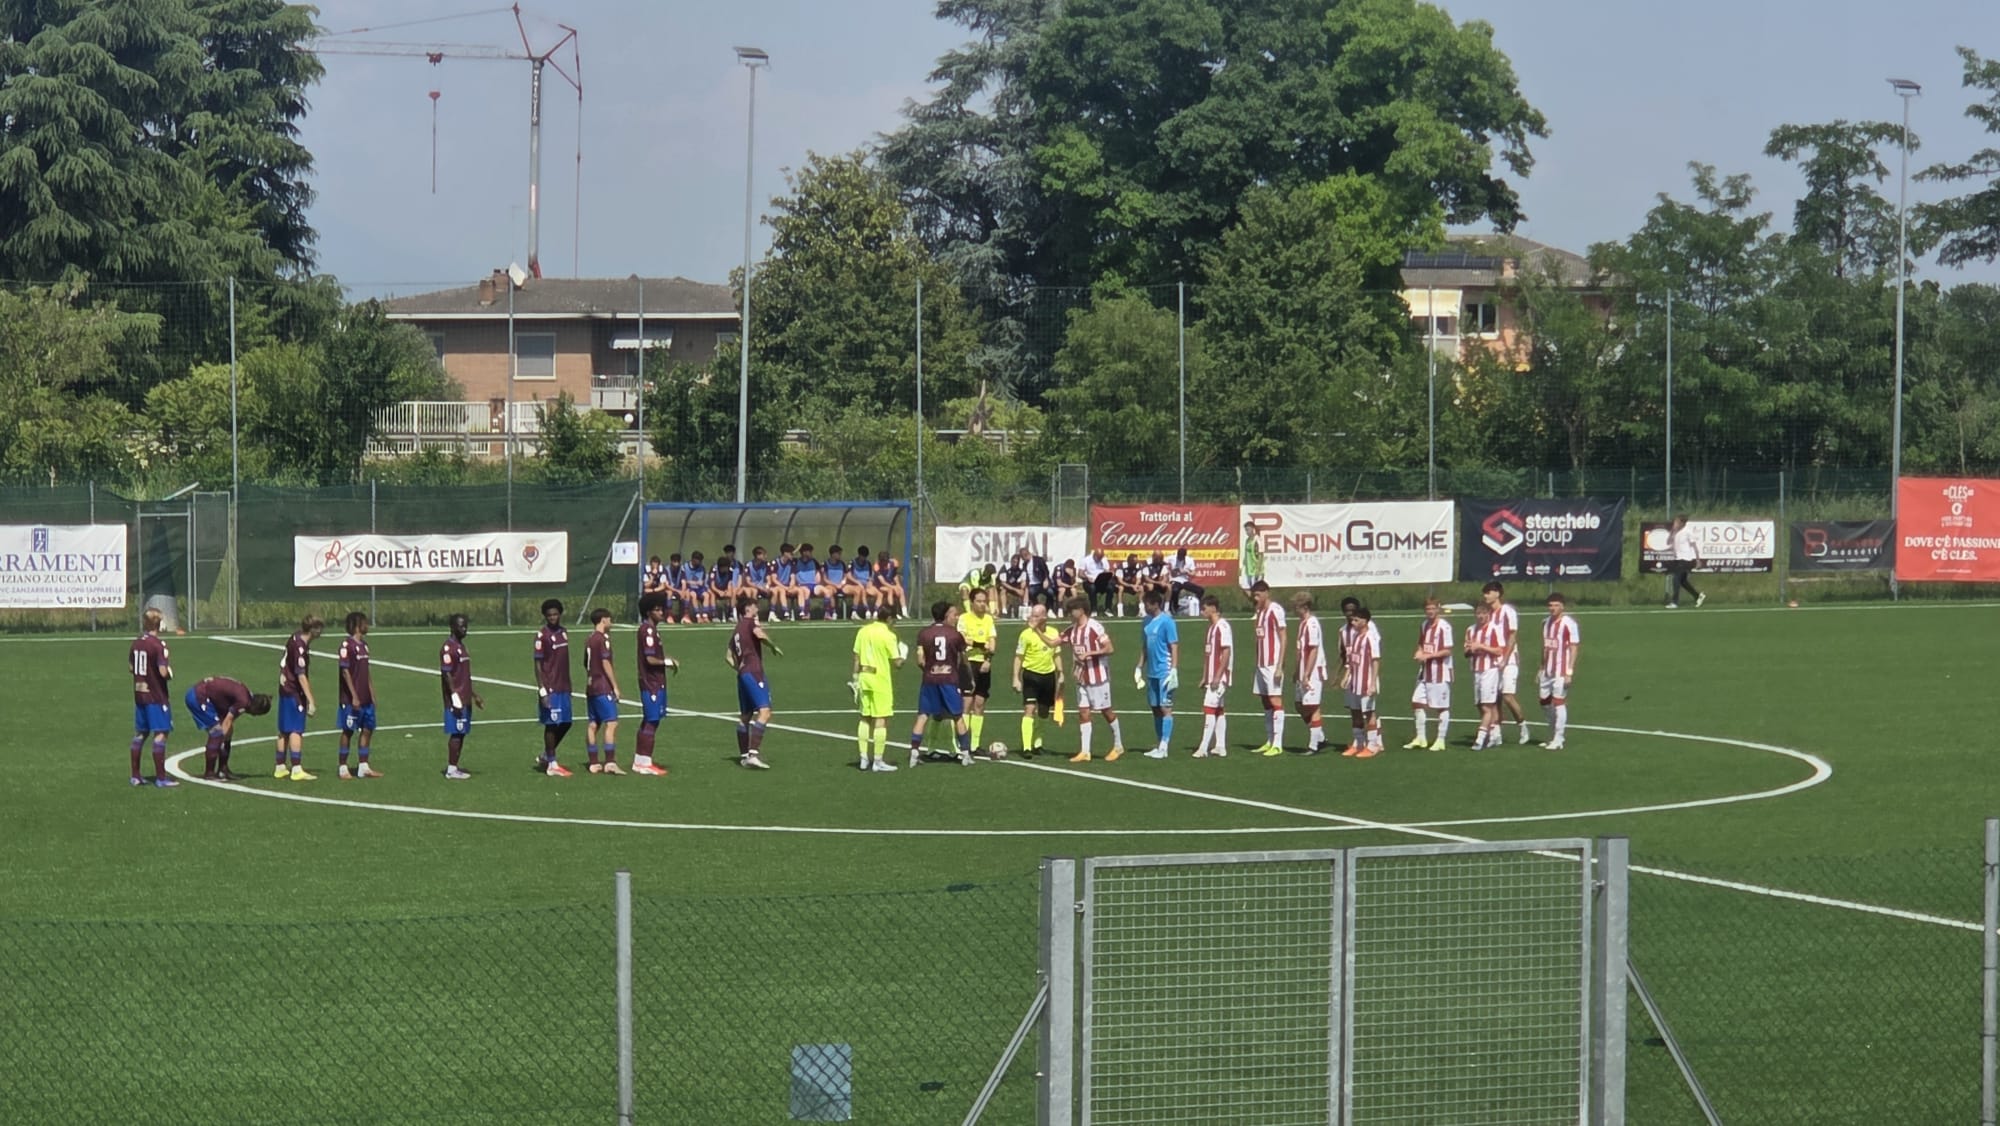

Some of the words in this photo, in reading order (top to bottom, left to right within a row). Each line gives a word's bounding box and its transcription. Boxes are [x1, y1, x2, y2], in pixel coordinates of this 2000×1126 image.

[1140, 511, 1181, 522] Trattoria
[1184, 511, 1193, 522] al
[1525, 512, 1600, 529] sterchele
[1248, 512, 1342, 553] PENDIN
[1525, 529, 1573, 547] group
[1904, 536, 1934, 547] DOVE
[1935, 534, 1951, 547] C'È
[354, 546, 423, 569] SOCIETÀ
[428, 548, 504, 569] GEMELLA
[1702, 545, 1731, 555] DELLA
[1931, 548, 1948, 560] C'È
[43, 574, 98, 584] ZUCCATO
[67, 596, 83, 604] 349
[935, 636, 947, 661] 3
[134, 650, 148, 676] 10
